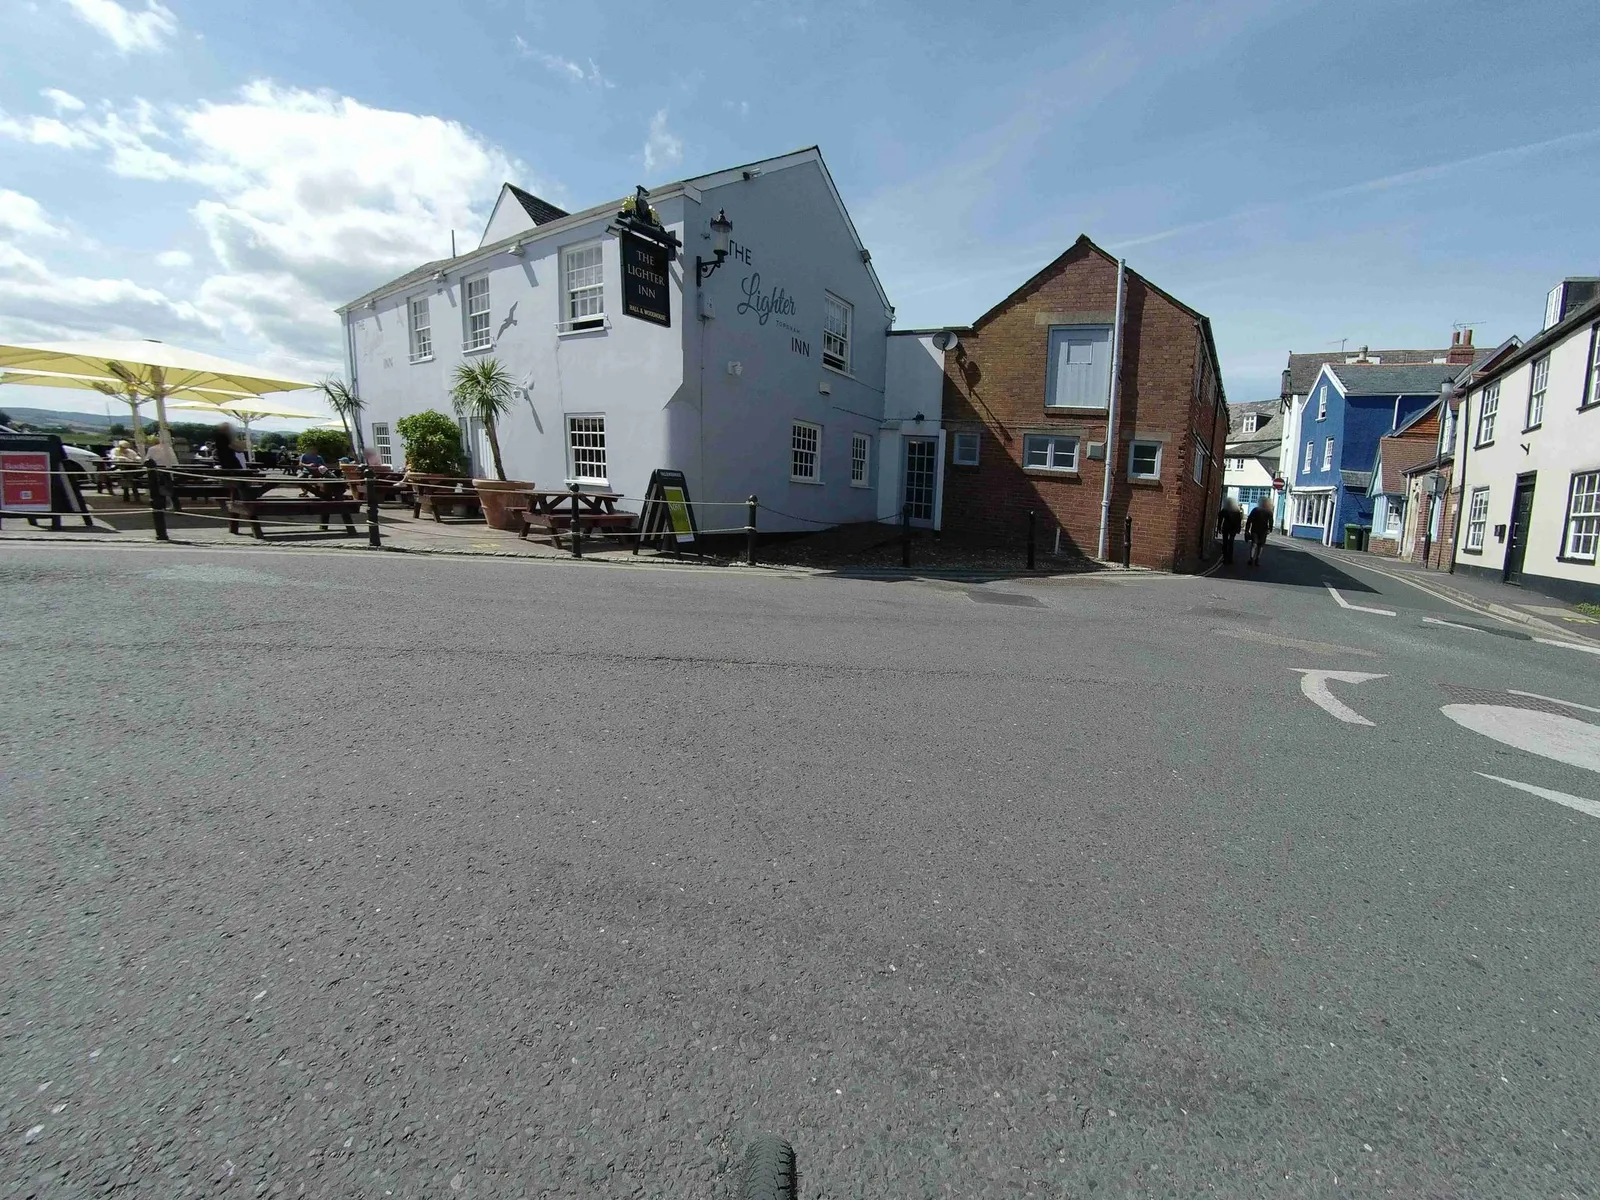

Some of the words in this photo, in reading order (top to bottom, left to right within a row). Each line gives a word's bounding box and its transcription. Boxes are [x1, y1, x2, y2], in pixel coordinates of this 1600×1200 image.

[636, 250, 655, 266] THE
[728, 239, 752, 266] THE
[627, 263, 666, 286] LIGHTER
[638, 285, 656, 299] INN
[737, 272, 796, 326] Lighter
[791, 337, 810, 357] INN
